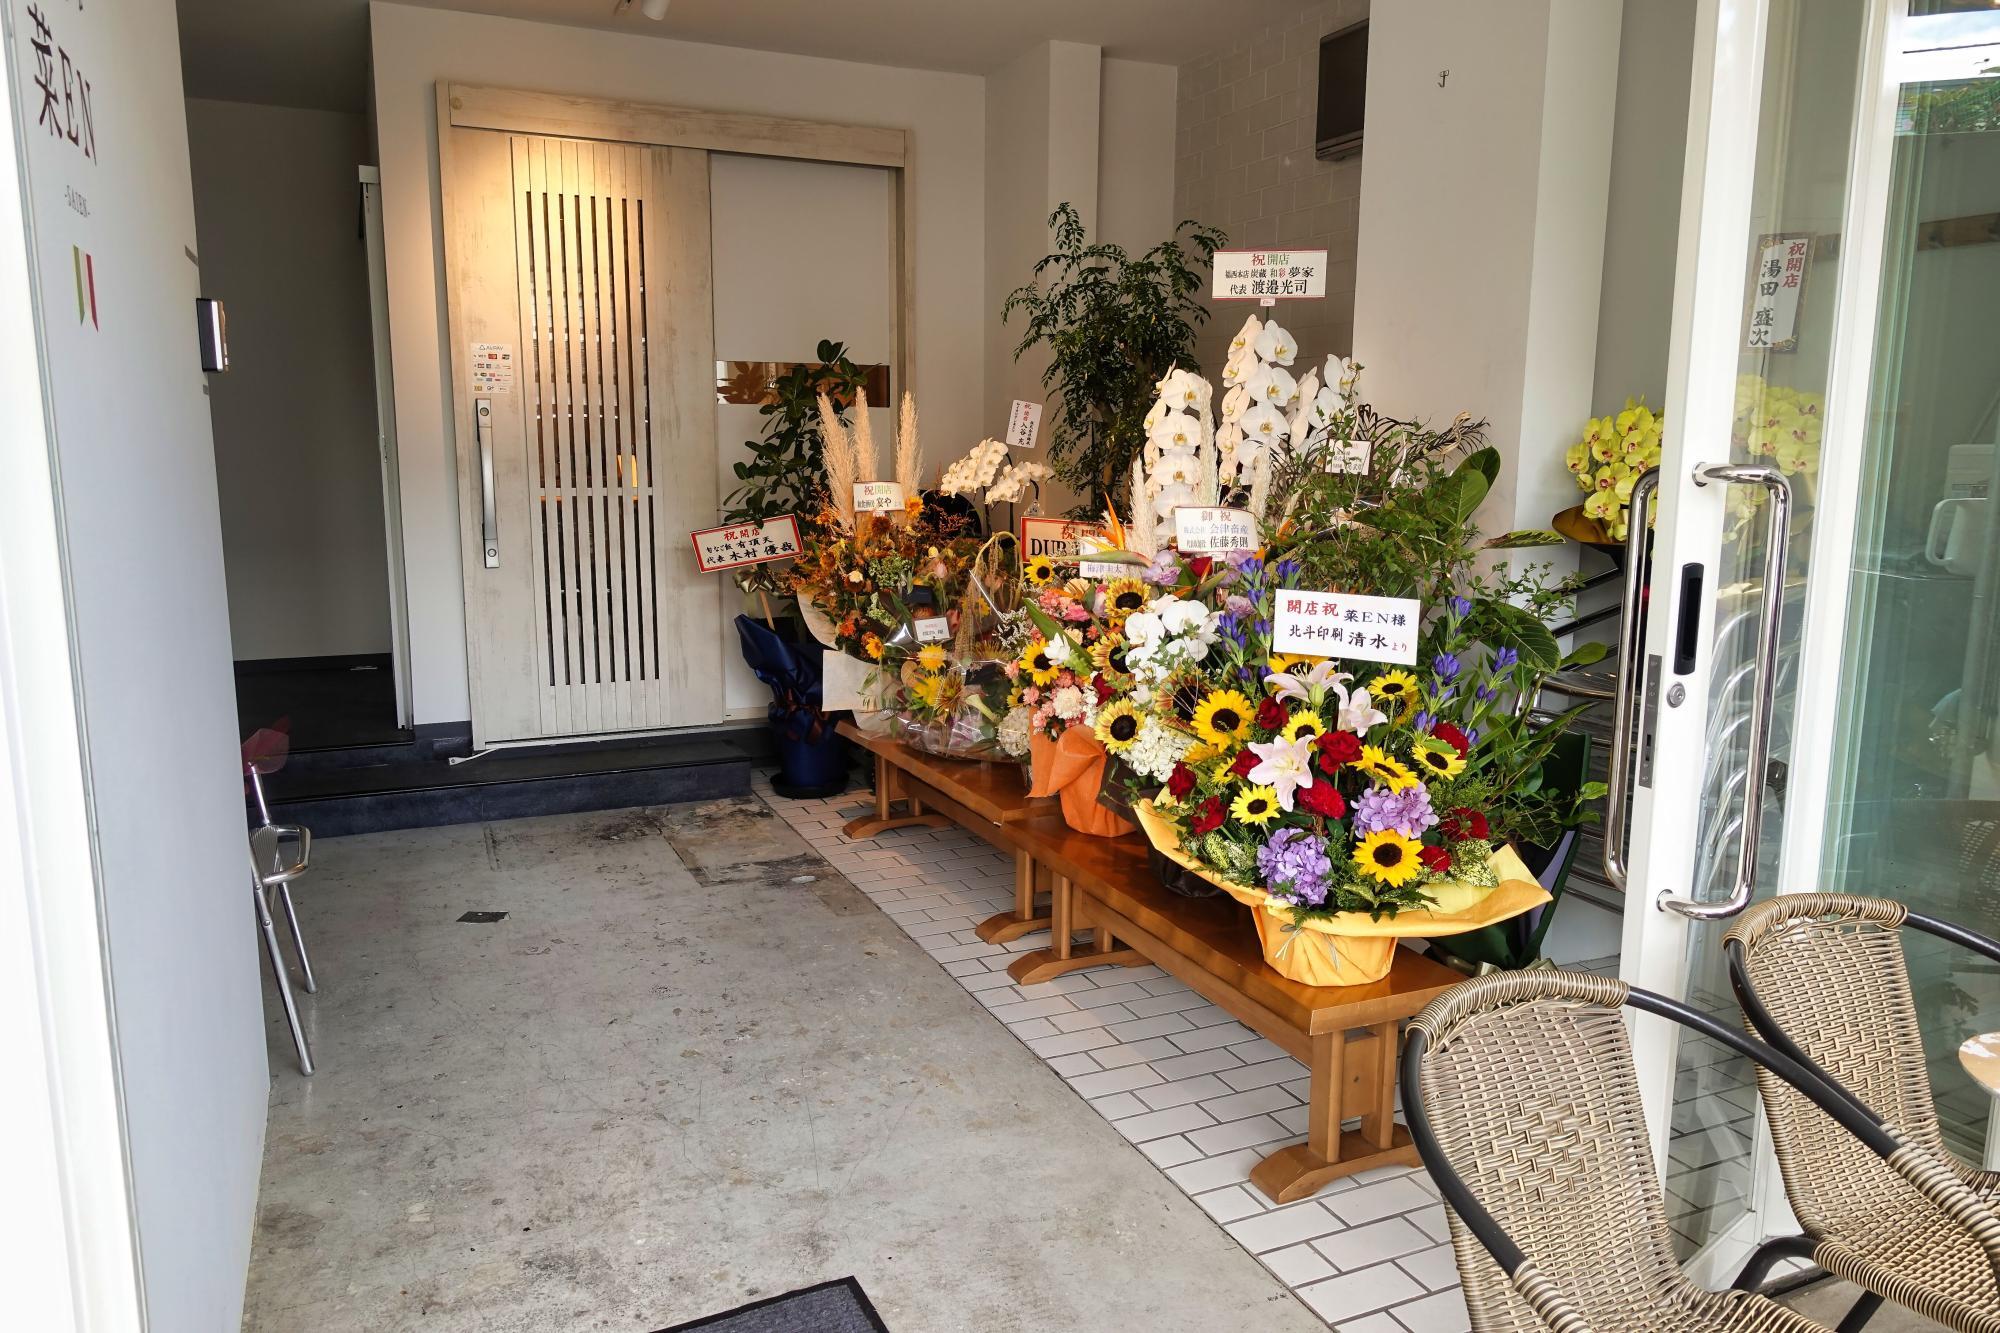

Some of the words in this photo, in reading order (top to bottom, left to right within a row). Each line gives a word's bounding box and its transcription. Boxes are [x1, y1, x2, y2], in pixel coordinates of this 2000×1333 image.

[27, 2, 97, 166] 菜EN
[1288, 266, 1315, 278] 夢家
[1782, 241, 1806, 288] 祝開店
[1230, 283, 1247, 295] 代表
[723, 526, 761, 541] 祝開店
[1287, 599, 1339, 617] 開店祝
[1288, 624, 1344, 642] 北斗印刷
[1347, 631, 1389, 650] 清水
